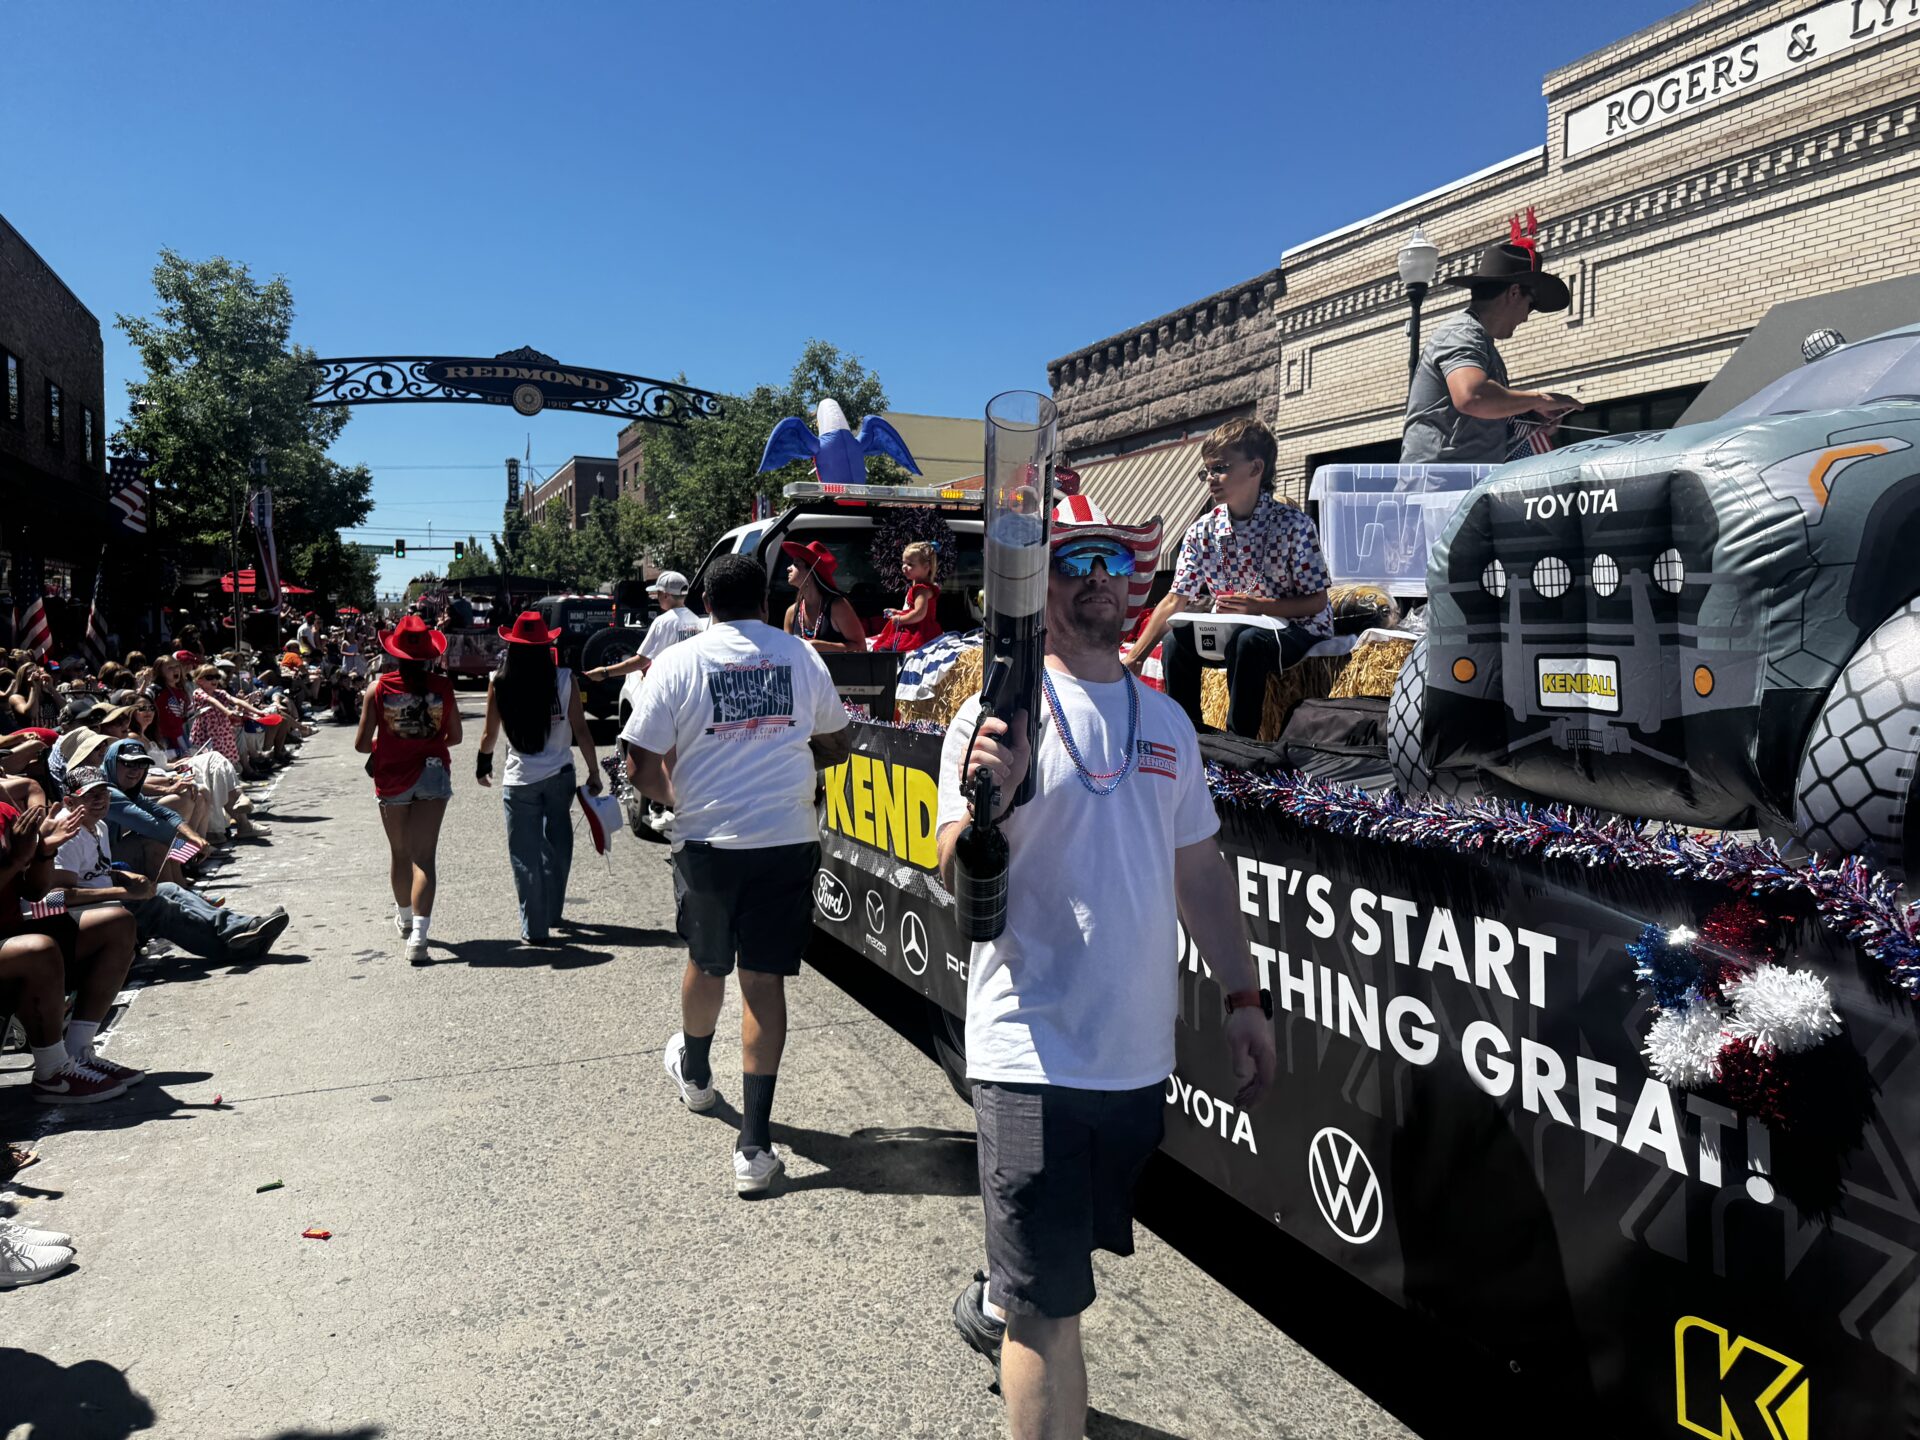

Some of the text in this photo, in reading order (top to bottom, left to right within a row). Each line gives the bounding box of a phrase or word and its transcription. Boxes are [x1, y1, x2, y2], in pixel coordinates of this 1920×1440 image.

[1605, 43, 1759, 136] ROGERS
[1786, 22, 1818, 64] &
[444, 366, 610, 392] REDMOND
[1556, 432, 1667, 456] TOYTA
[510, 467, 518, 504] HOTEL
[1523, 488, 1619, 520] TOYOTA
[724, 662, 757, 673] Driven
[1542, 672, 1617, 697] KENDALL
[824, 753, 940, 869] KEND
[817, 873, 844, 916] Ford
[1222, 852, 1557, 1008] ET'S START
[1177, 919, 1775, 1204] THING GREAT!
[1165, 1073, 1258, 1155] OYOTA
